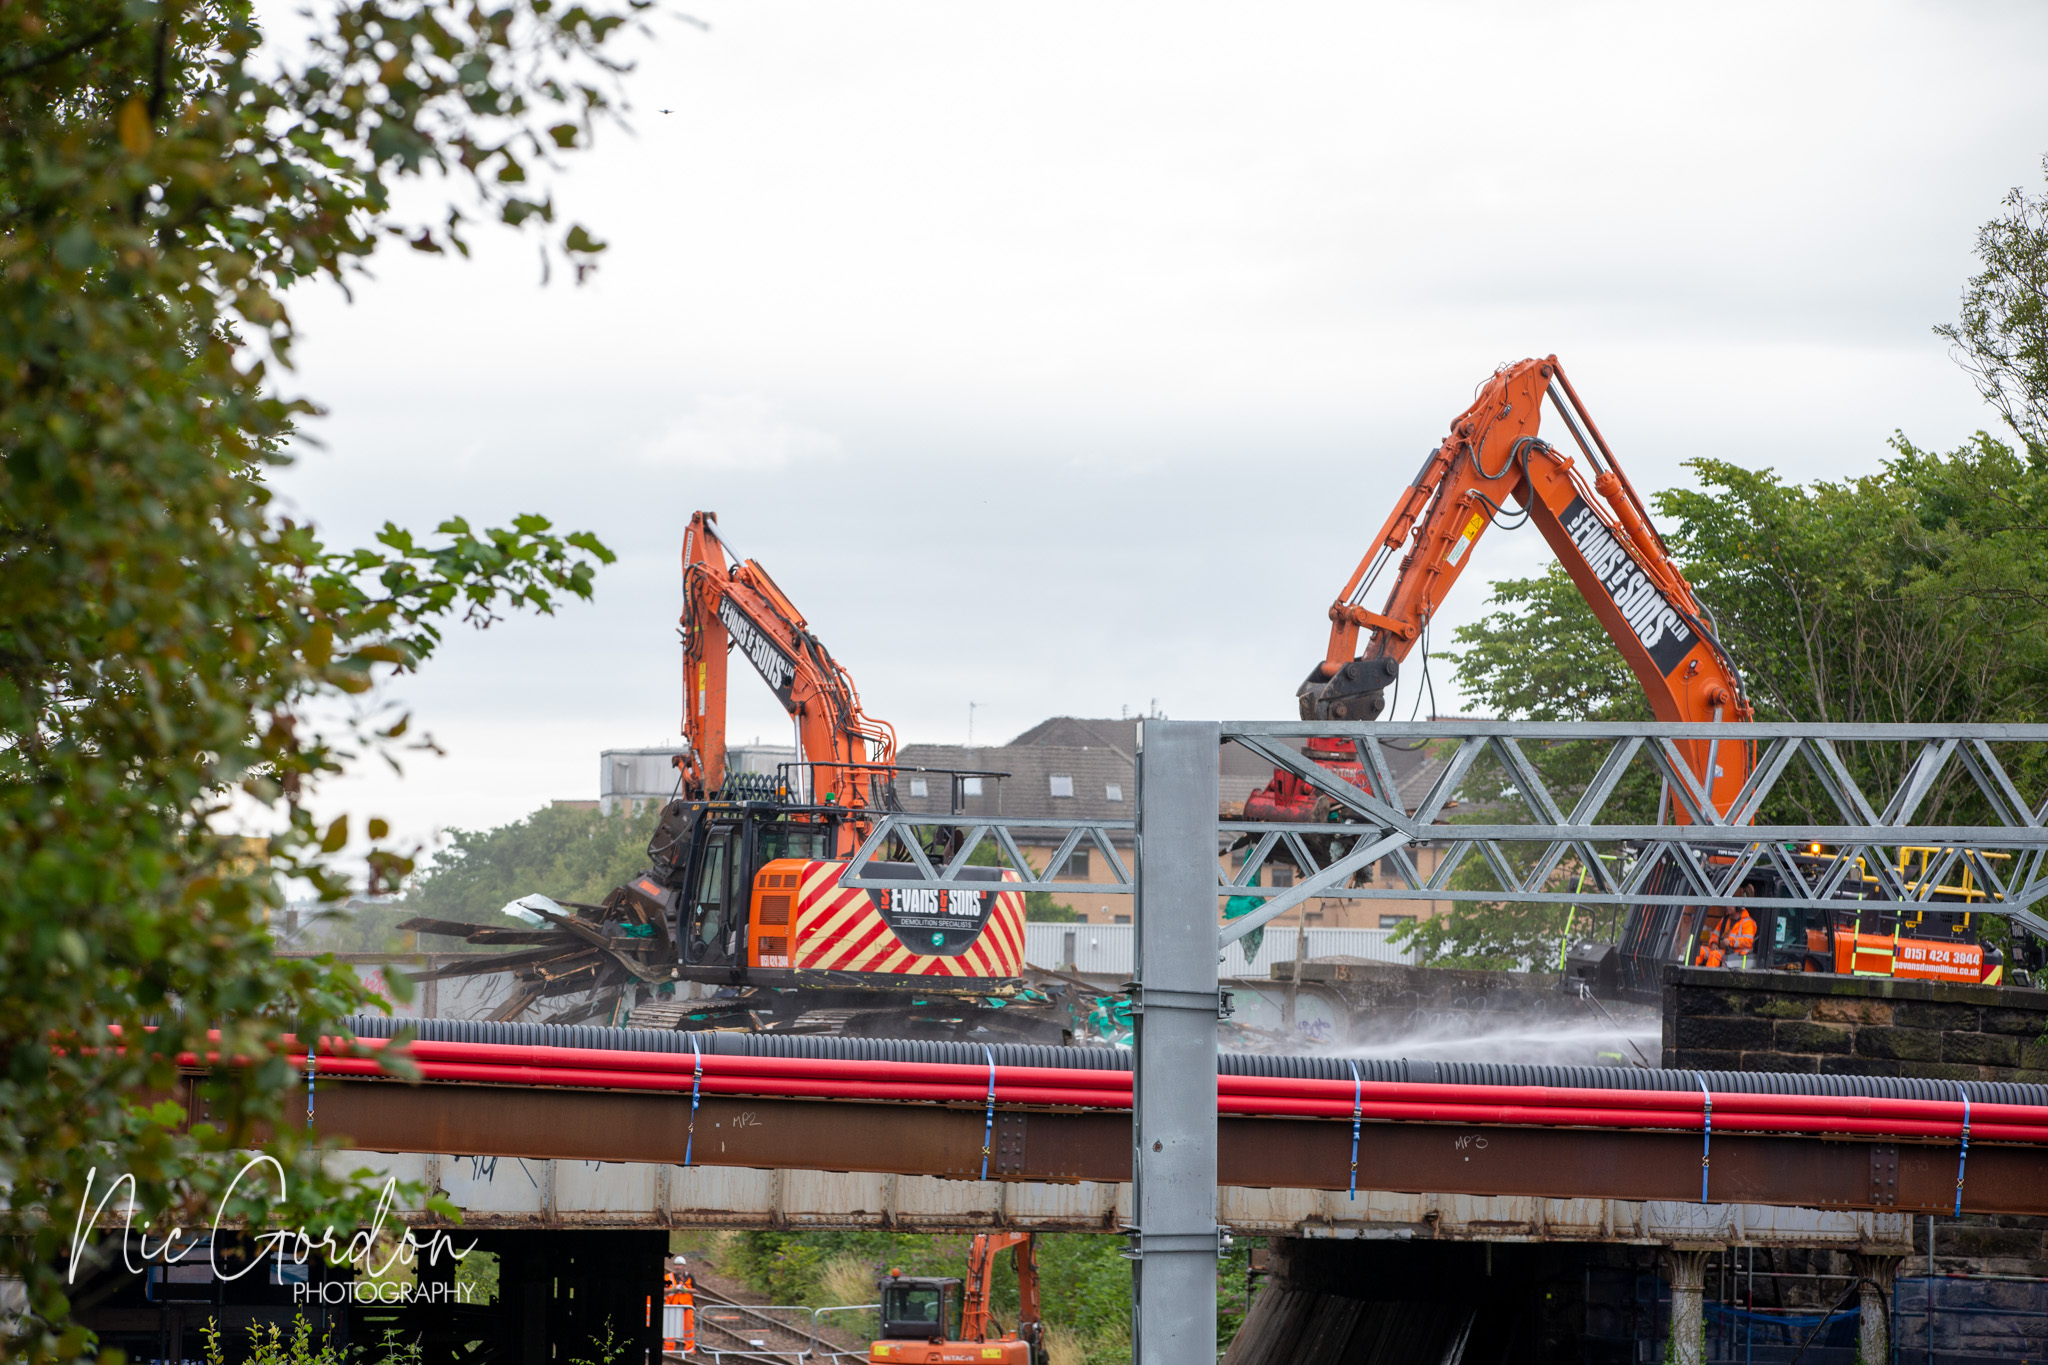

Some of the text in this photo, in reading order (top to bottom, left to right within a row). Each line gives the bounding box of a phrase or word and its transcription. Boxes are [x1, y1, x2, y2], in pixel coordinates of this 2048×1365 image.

[1571, 514, 1626, 581] EVANS
[1606, 559, 1635, 592] &
[1613, 571, 1677, 649] SONS
[1670, 619, 1690, 642] LTD
[723, 604, 749, 647] EVANS
[745, 628, 755, 652] &
[751, 634, 783, 690] SONS
[891, 888, 939, 914] EVANS
[939, 889, 948, 912] &
[949, 889, 981, 917] SONS
[900, 918, 972, 929] DEMOLITION SPECIALISTS
[1894, 961, 1980, 977] sevansdemolition.co.uk
[1904, 947, 1927, 960] 0151
[1929, 949, 1950, 963] 424
[1952, 951, 1980, 966] 3944
[732, 1111, 762, 1129] MP2
